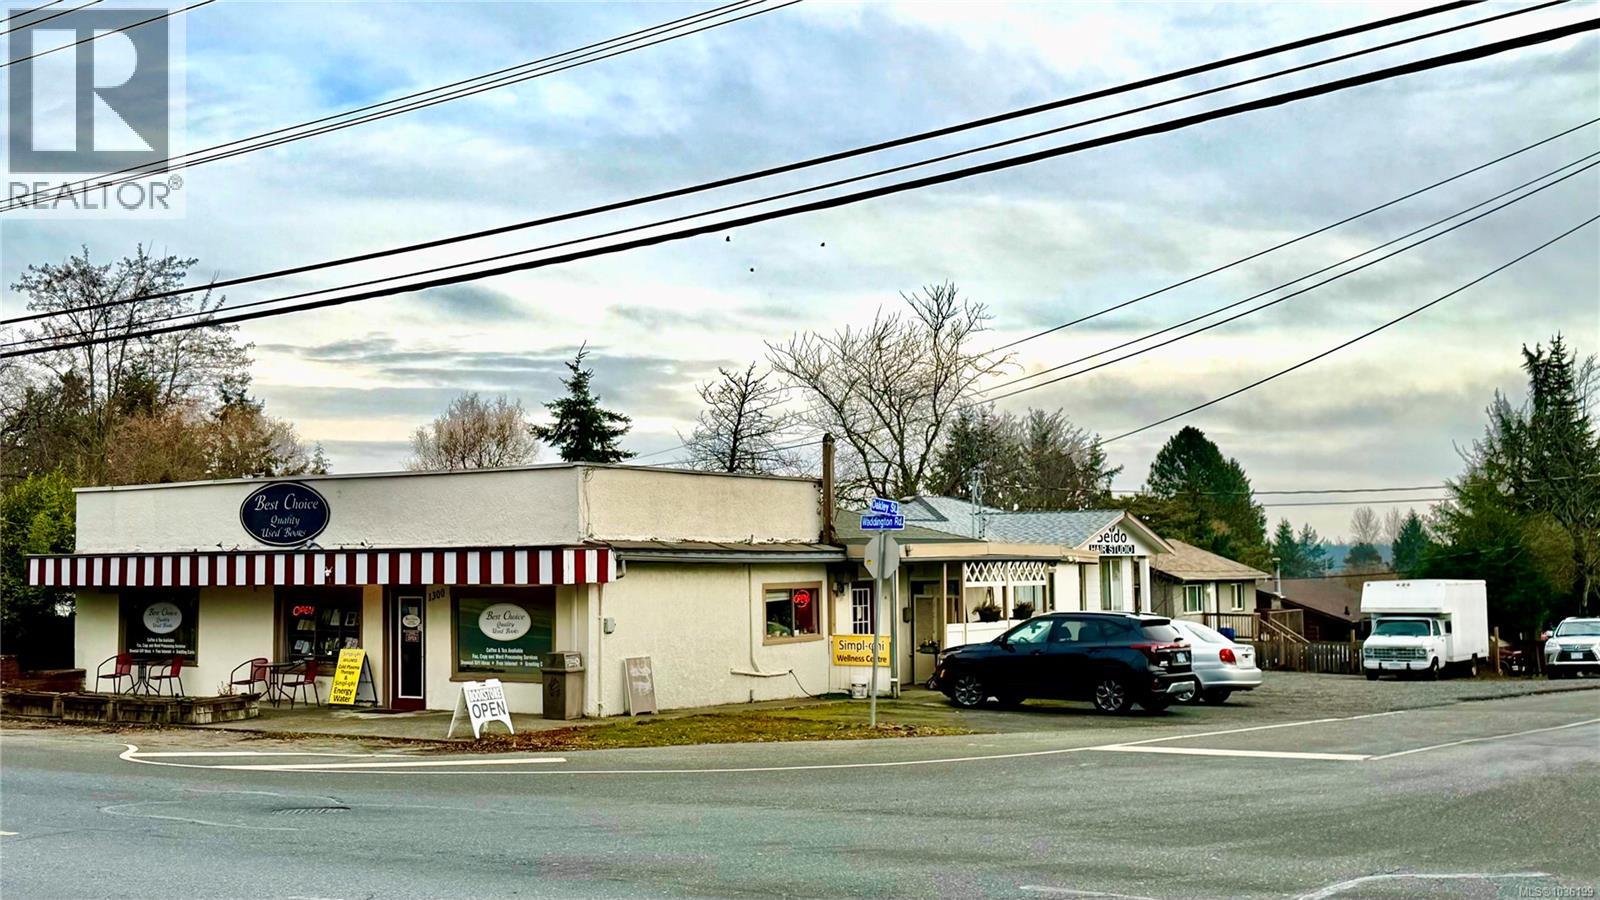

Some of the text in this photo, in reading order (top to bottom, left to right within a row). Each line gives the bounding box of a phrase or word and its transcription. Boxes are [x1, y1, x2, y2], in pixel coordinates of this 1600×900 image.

[254, 493, 319, 511] Best Choice
[872, 498, 889, 513] Oakley
[270, 514, 301, 528] Quality
[862, 516, 893, 528] Waddington
[261, 527, 307, 538] Used Books
[1097, 528, 1127, 543] Seido
[1109, 545, 1134, 554] STUDIO
[428, 588, 446, 602] 1300
[292, 605, 315, 616] OPEN
[486, 610, 525, 620] Best Choice
[836, 654, 887, 663] Wellness Cetre
[333, 687, 353, 696] Energy
[471, 700, 507, 719] OPEN
